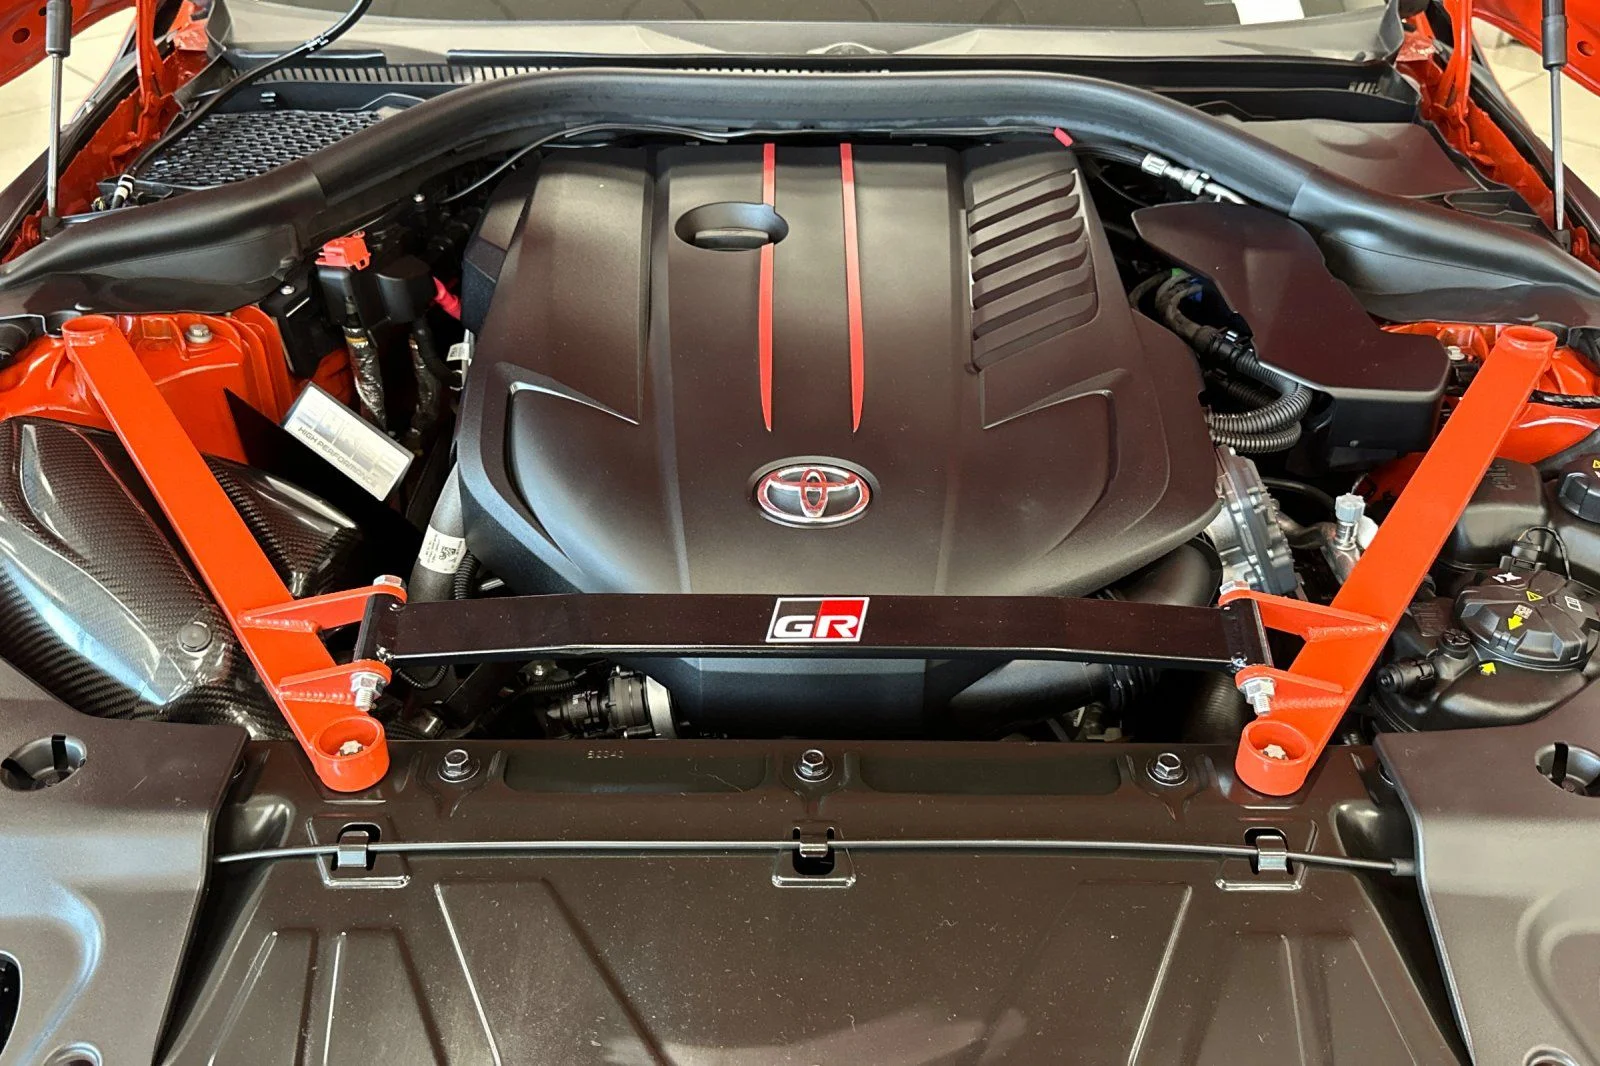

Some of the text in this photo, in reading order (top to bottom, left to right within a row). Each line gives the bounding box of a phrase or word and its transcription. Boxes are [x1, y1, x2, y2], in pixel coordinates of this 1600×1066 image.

[297, 427, 378, 489] HIGH PERFORMANCE
[773, 615, 859, 637] GR
